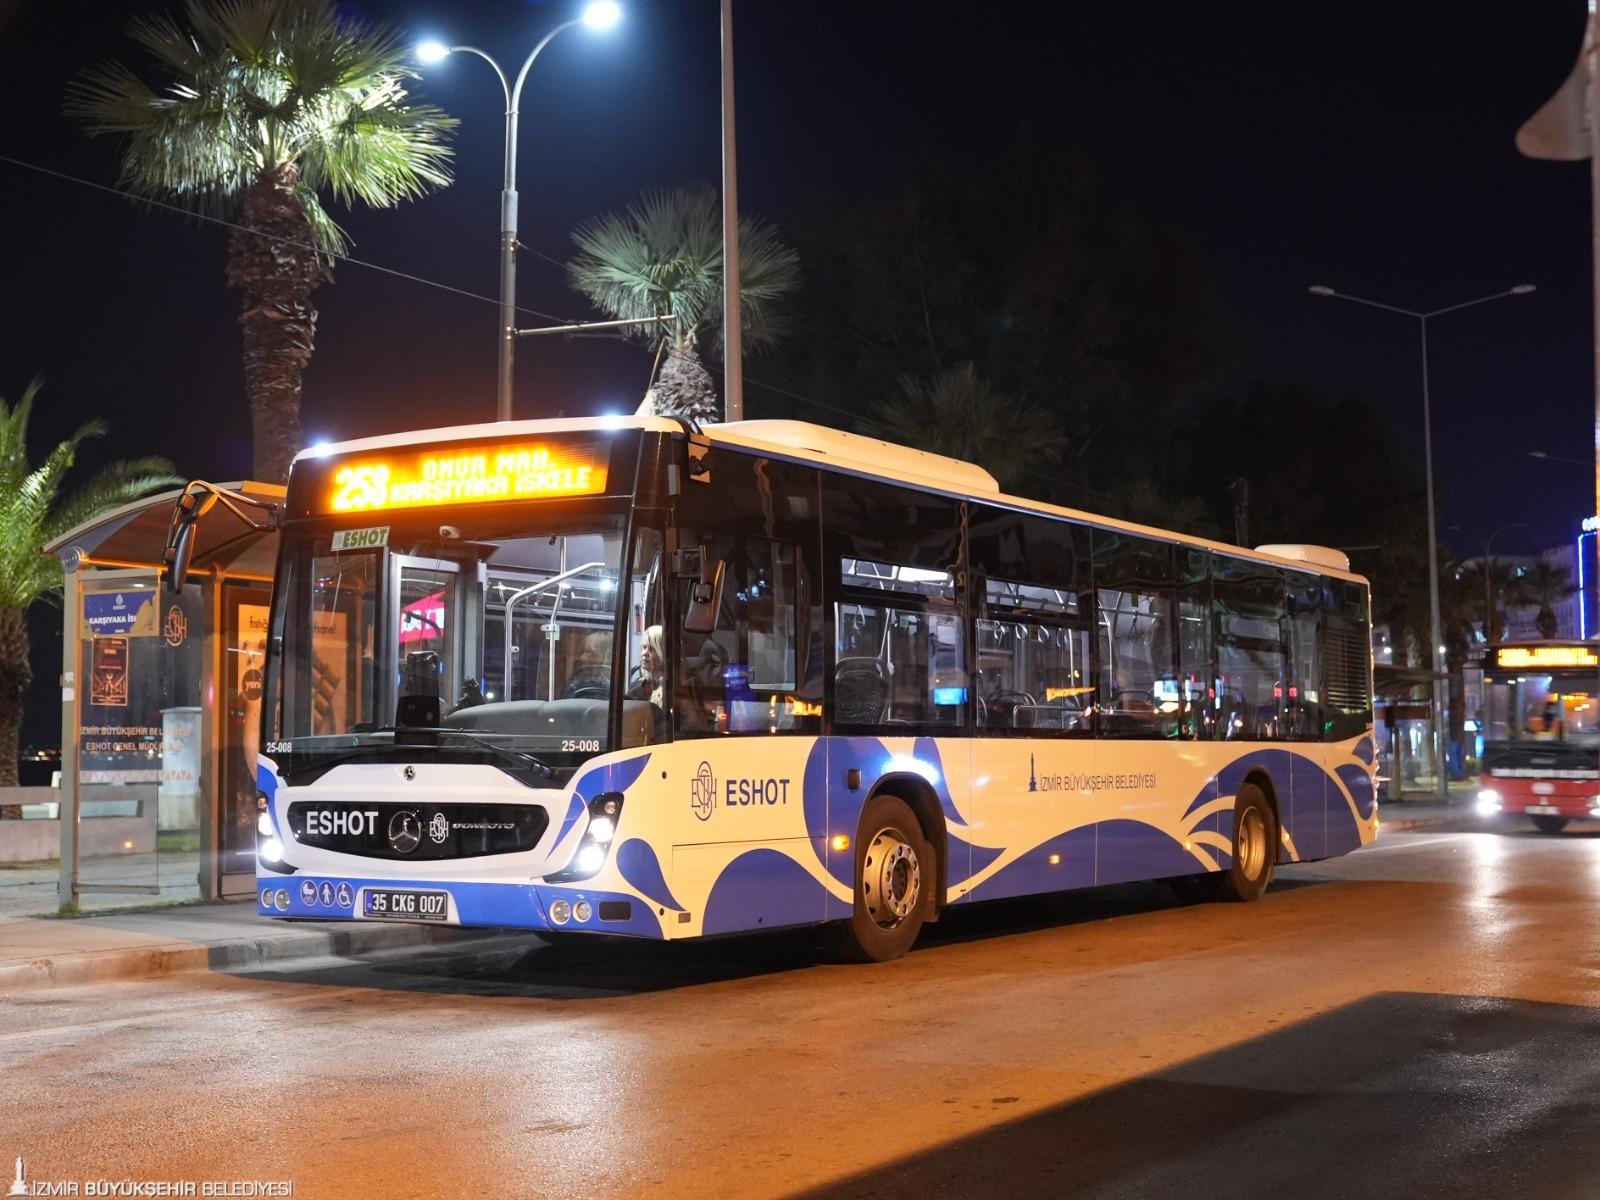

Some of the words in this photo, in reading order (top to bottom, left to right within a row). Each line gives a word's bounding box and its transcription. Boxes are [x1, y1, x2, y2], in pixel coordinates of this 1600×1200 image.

[334, 465, 389, 511] 258
[342, 529, 387, 547] ESHOT
[266, 742, 292, 753] 25-008
[561, 739, 600, 752] 25-008
[726, 778, 790, 806] ESHOT
[1040, 773, 1062, 791] İZMİR
[1064, 772, 1114, 793] BÜYÜKŞEHİR
[1116, 771, 1156, 789] BELEDİYESİ
[306, 810, 379, 836] ESHOT
[372, 893, 387, 911] 35
[392, 894, 415, 912] CKG
[420, 895, 444, 913] 007
